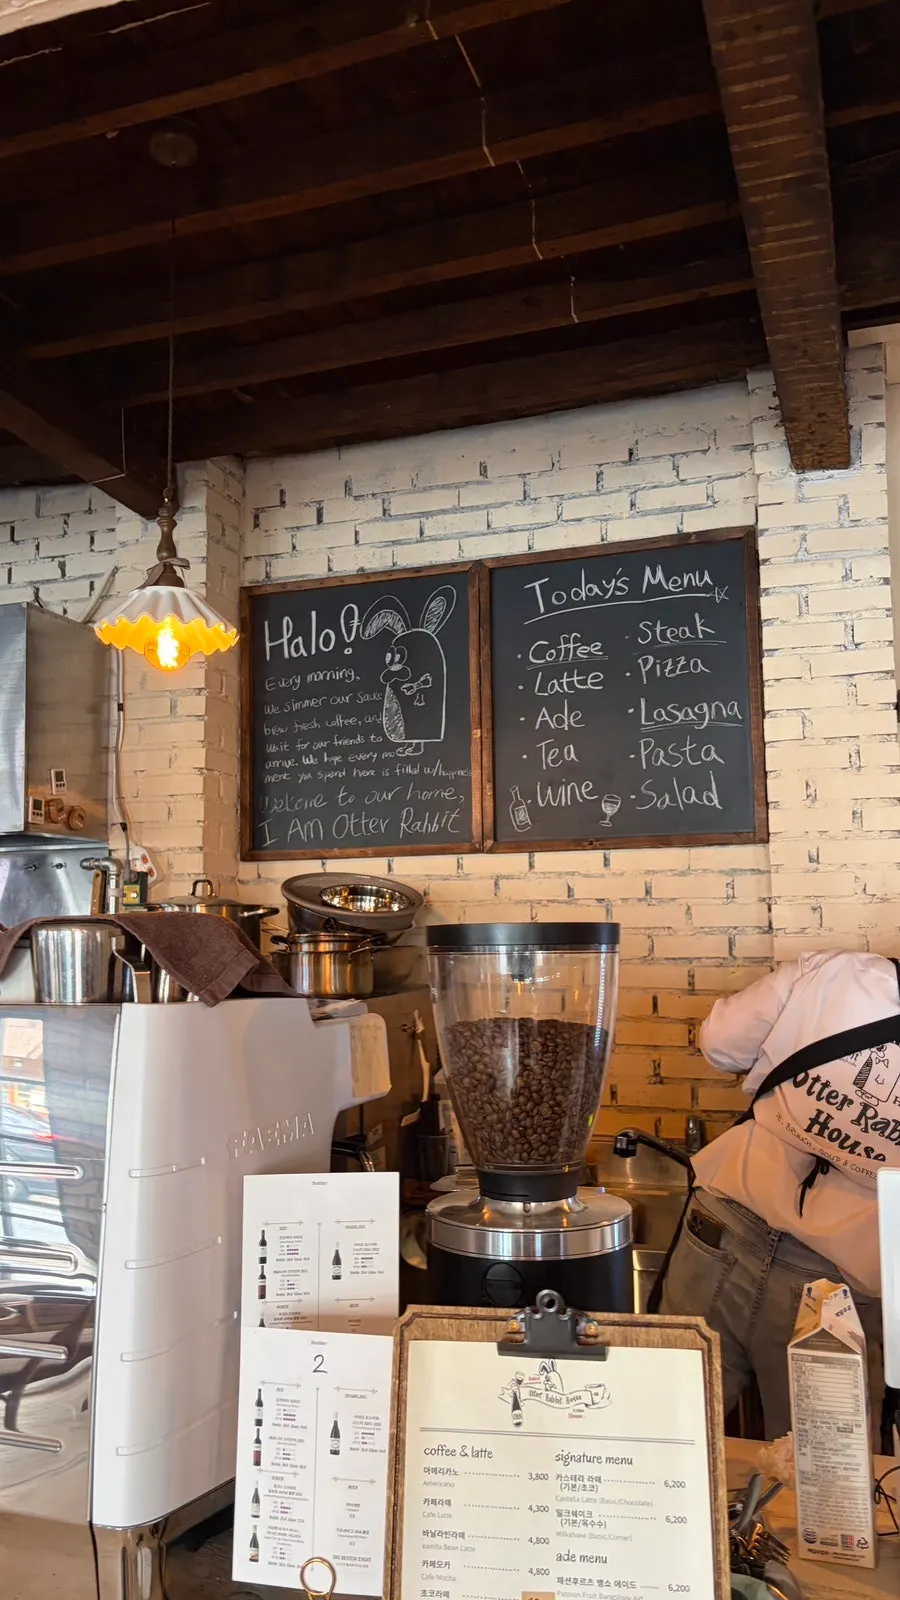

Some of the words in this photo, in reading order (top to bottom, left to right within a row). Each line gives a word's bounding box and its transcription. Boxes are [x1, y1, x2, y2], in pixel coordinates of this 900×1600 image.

[524, 567, 631, 613] Today's
[642, 564, 713, 594] Menu
[637, 612, 716, 645] Steak
[528, 632, 604, 664] Coffee
[265, 676, 300, 691] Every
[307, 667, 360, 683] morning,
[637, 655, 711, 685] Pizza
[535, 668, 604, 696] Latte
[283, 695, 327, 712] simmer
[330, 693, 353, 705] our
[535, 699, 586, 731] Ade
[640, 697, 743, 730] Lasagna
[263, 723, 288, 736] brew
[293, 717, 321, 734] fresh
[325, 713, 362, 728] coffee,
[364, 712, 383, 724] and
[296, 738, 310, 751] for
[312, 740, 331, 751] our
[333, 733, 365, 747] friends
[370, 734, 383, 743] to
[302, 754, 320, 765] We
[323, 751, 343, 766] hope
[348, 750, 378, 763] every
[536, 738, 580, 770] Tea
[638, 735, 725, 769] Pasta
[298, 771, 313, 784] you
[317, 769, 346, 782] spend
[353, 768, 376, 777] here
[382, 768, 390, 777] is
[394, 763, 420, 776] filled
[259, 792, 328, 814] Welcome
[337, 784, 355, 807] to
[365, 785, 402, 804] our
[407, 781, 465, 804] home,
[636, 770, 723, 811] Salad
[258, 818, 280, 848] I
[332, 813, 391, 840] Otter
[399, 806, 461, 839] Rabbit
[850, 1101, 900, 1146] Rab
[312, 1354, 328, 1374] 2
[423, 1444, 457, 1458] coffee
[459, 1445, 469, 1458] &
[471, 1446, 494, 1459] latte
[555, 1450, 603, 1466] signature
[605, 1455, 633, 1465] menu
[423, 1466, 459, 1476] 아메리카노
[528, 1472, 549, 1482] 3,800
[555, 1474, 585, 1483] 카스테라
[587, 1475, 602, 1484] 라떼
[664, 1480, 686, 1489] 6,200
[423, 1480, 455, 1488] Americano
[560, 1483, 599, 1493] (기본/초코)
[423, 1498, 451, 1507] 카페라떼
[528, 1505, 549, 1514] 4,300
[555, 1495, 580, 1503] Castella
[665, 1515, 688, 1524] 6,200
[422, 1529, 466, 1540] 바닐라빈라떼
[528, 1537, 549, 1547] 4,800
[555, 1550, 577, 1562] ade
[579, 1553, 607, 1564] menu
[421, 1560, 451, 1569] 카페모카
[528, 1567, 550, 1576] 4,800
[420, 1590, 450, 1599] 초코라떼
[613, 1580, 637, 1589] 에이드
[668, 1584, 690, 1593] 6,200
